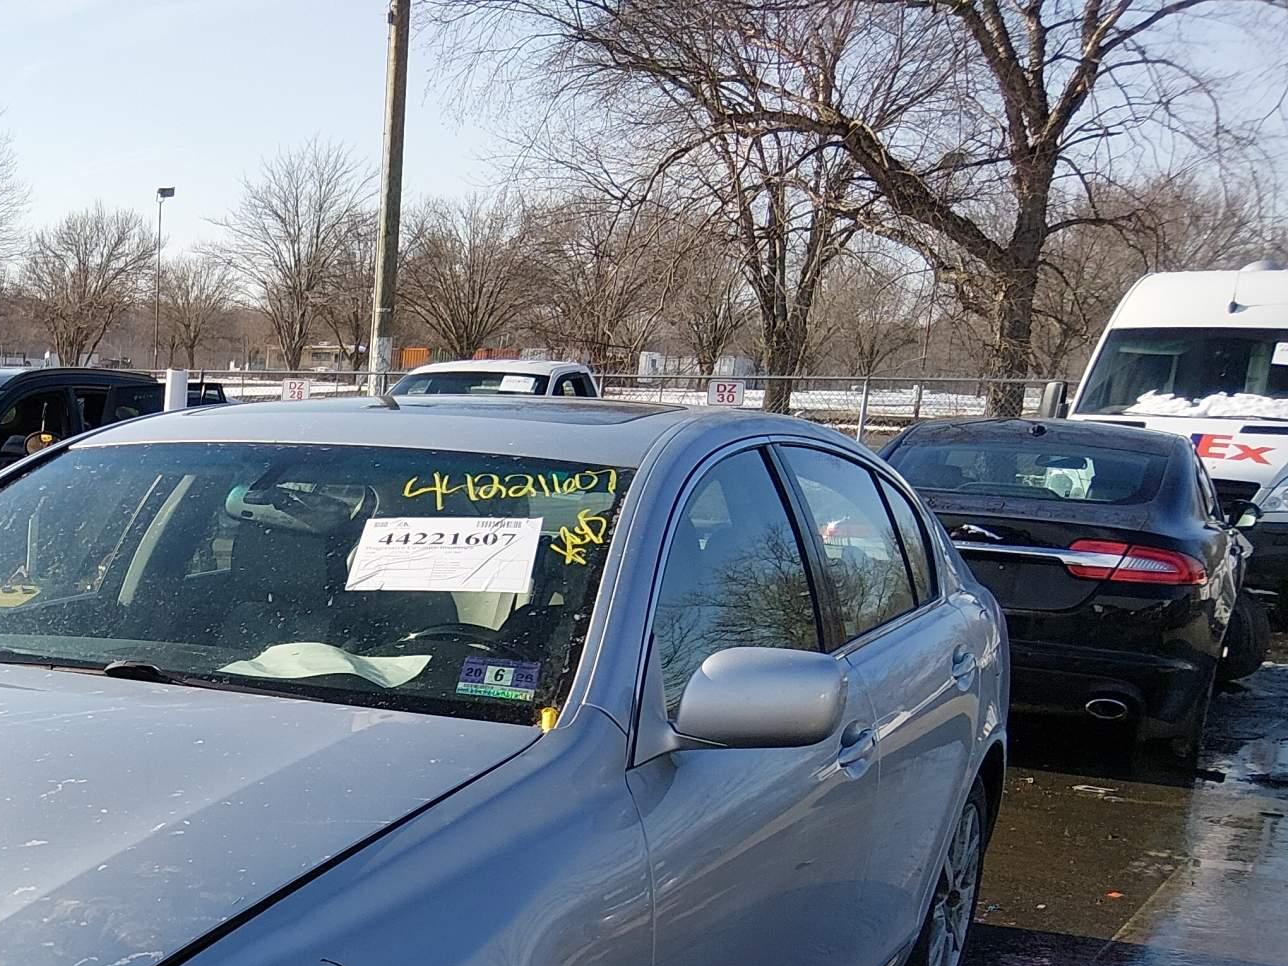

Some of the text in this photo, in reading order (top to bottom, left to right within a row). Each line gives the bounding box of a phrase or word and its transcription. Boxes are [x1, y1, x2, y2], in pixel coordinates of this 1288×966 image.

[289, 381, 305, 390] DZ
[716, 383, 737, 394] DZ
[716, 393, 735, 403] 30
[403, 469, 617, 511] 44221607
[377, 531, 518, 546] 44221607
[465, 667, 535, 683] 20 6 26
